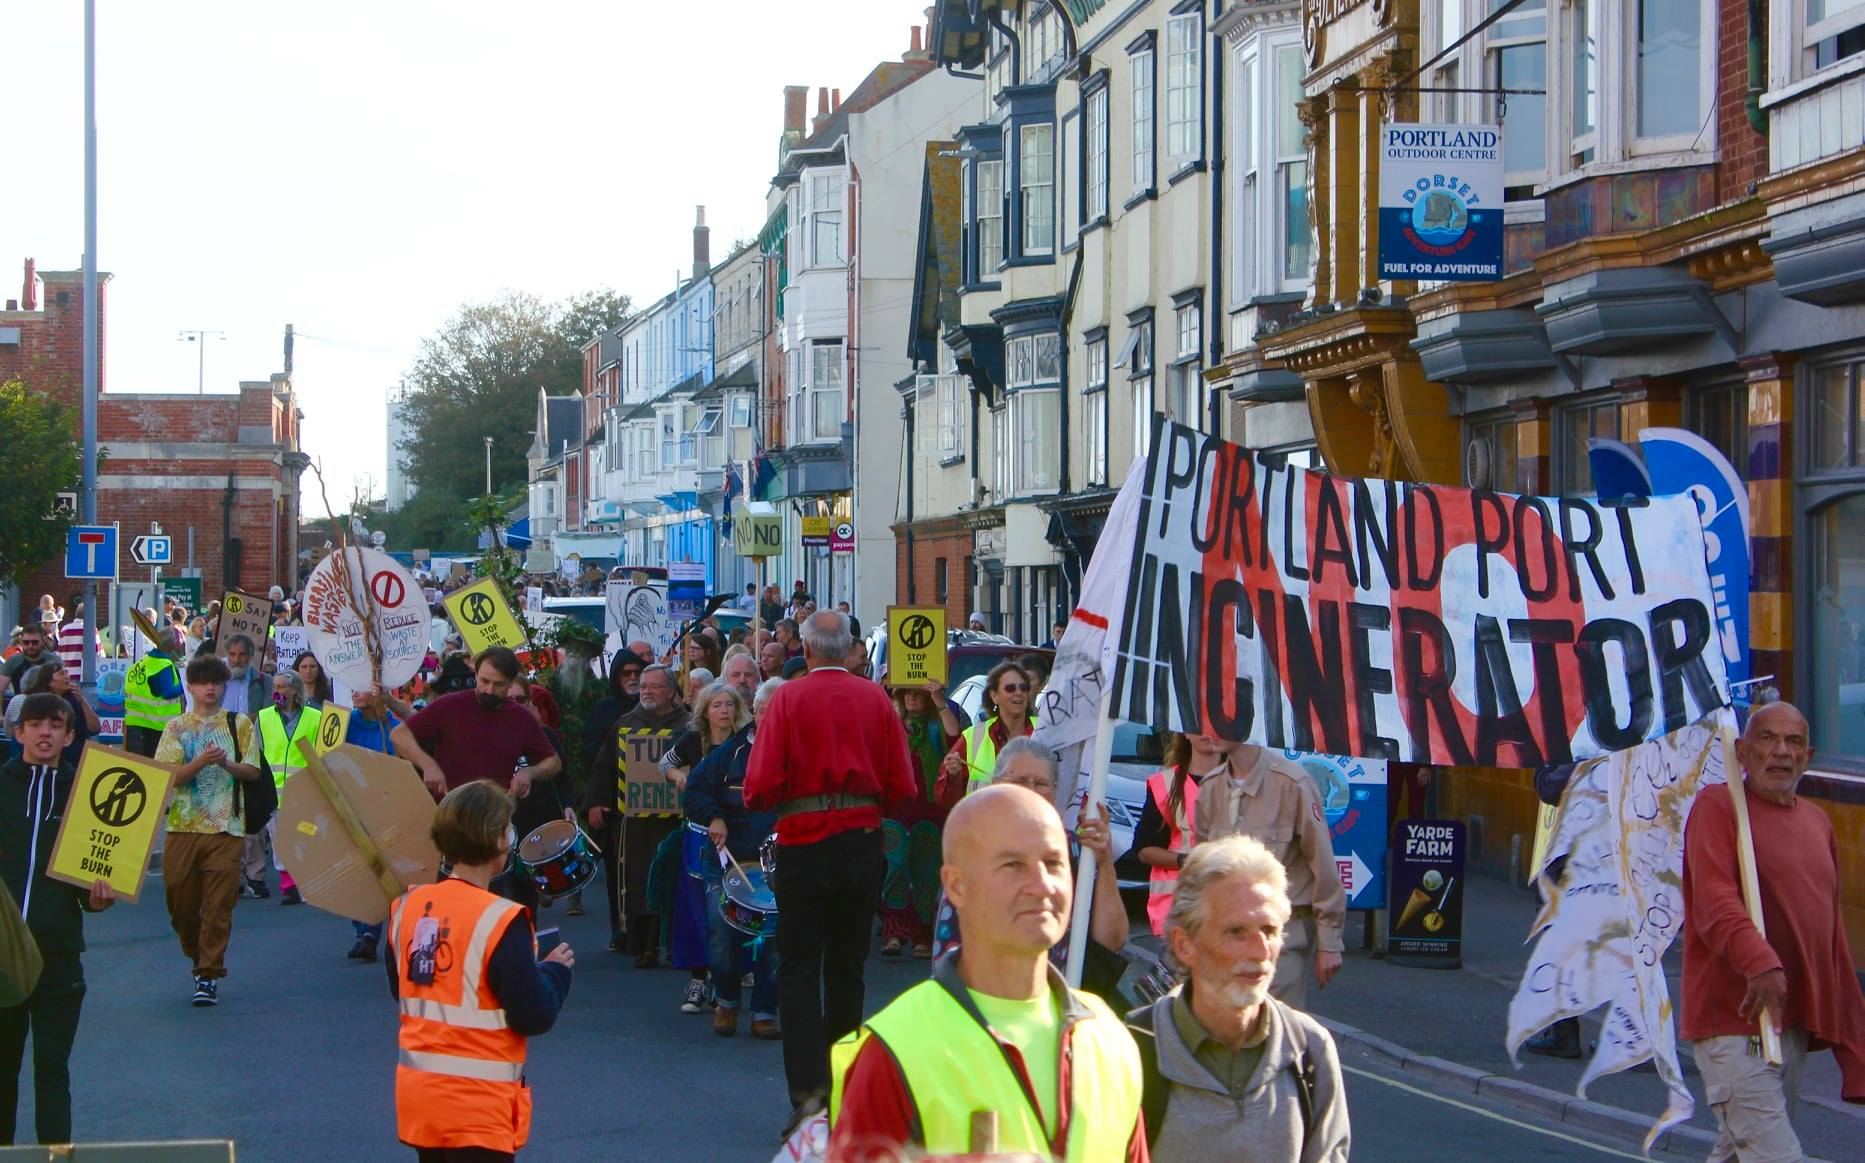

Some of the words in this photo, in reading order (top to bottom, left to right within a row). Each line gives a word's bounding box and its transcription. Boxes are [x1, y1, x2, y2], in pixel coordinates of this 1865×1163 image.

[1389, 130, 1497, 148] PORTLAND
[1388, 148, 1447, 159] OUTDOOR
[1450, 149, 1497, 160] CENTRE
[1402, 174, 1480, 205] DORSET
[1384, 263, 1408, 273] FUEL
[1410, 263, 1432, 274] FOR
[1433, 264, 1497, 275] ADVENTURE
[1158, 420, 1445, 592] PORTLAND
[1470, 489, 1651, 604] PORT
[736, 516, 752, 552] NO
[754, 524, 780, 546] NO
[151, 540, 166, 559] P
[232, 618, 247, 630] NO
[342, 621, 362, 636] NOT
[383, 613, 416, 628] REDUCE
[280, 629, 300, 645] Keep
[390, 628, 417, 641] WASTE
[480, 623, 498, 637] STOP
[486, 632, 500, 643] THE
[328, 649, 365, 665] ANSWER
[387, 646, 419, 659] SOURCE
[907, 653, 927, 661] STOP
[1128, 552, 1733, 767] INCINERATOR
[910, 662, 923, 670] THE
[907, 671, 928, 679] BURN
[627, 782, 682, 809] RENE
[89, 829, 121, 848] STOP
[1407, 824, 1454, 840] YARDE
[90, 844, 112, 862] THE
[1406, 839, 1454, 856] FARM
[80, 857, 113, 878] BURN
[1635, 892, 1681, 967] STOP
